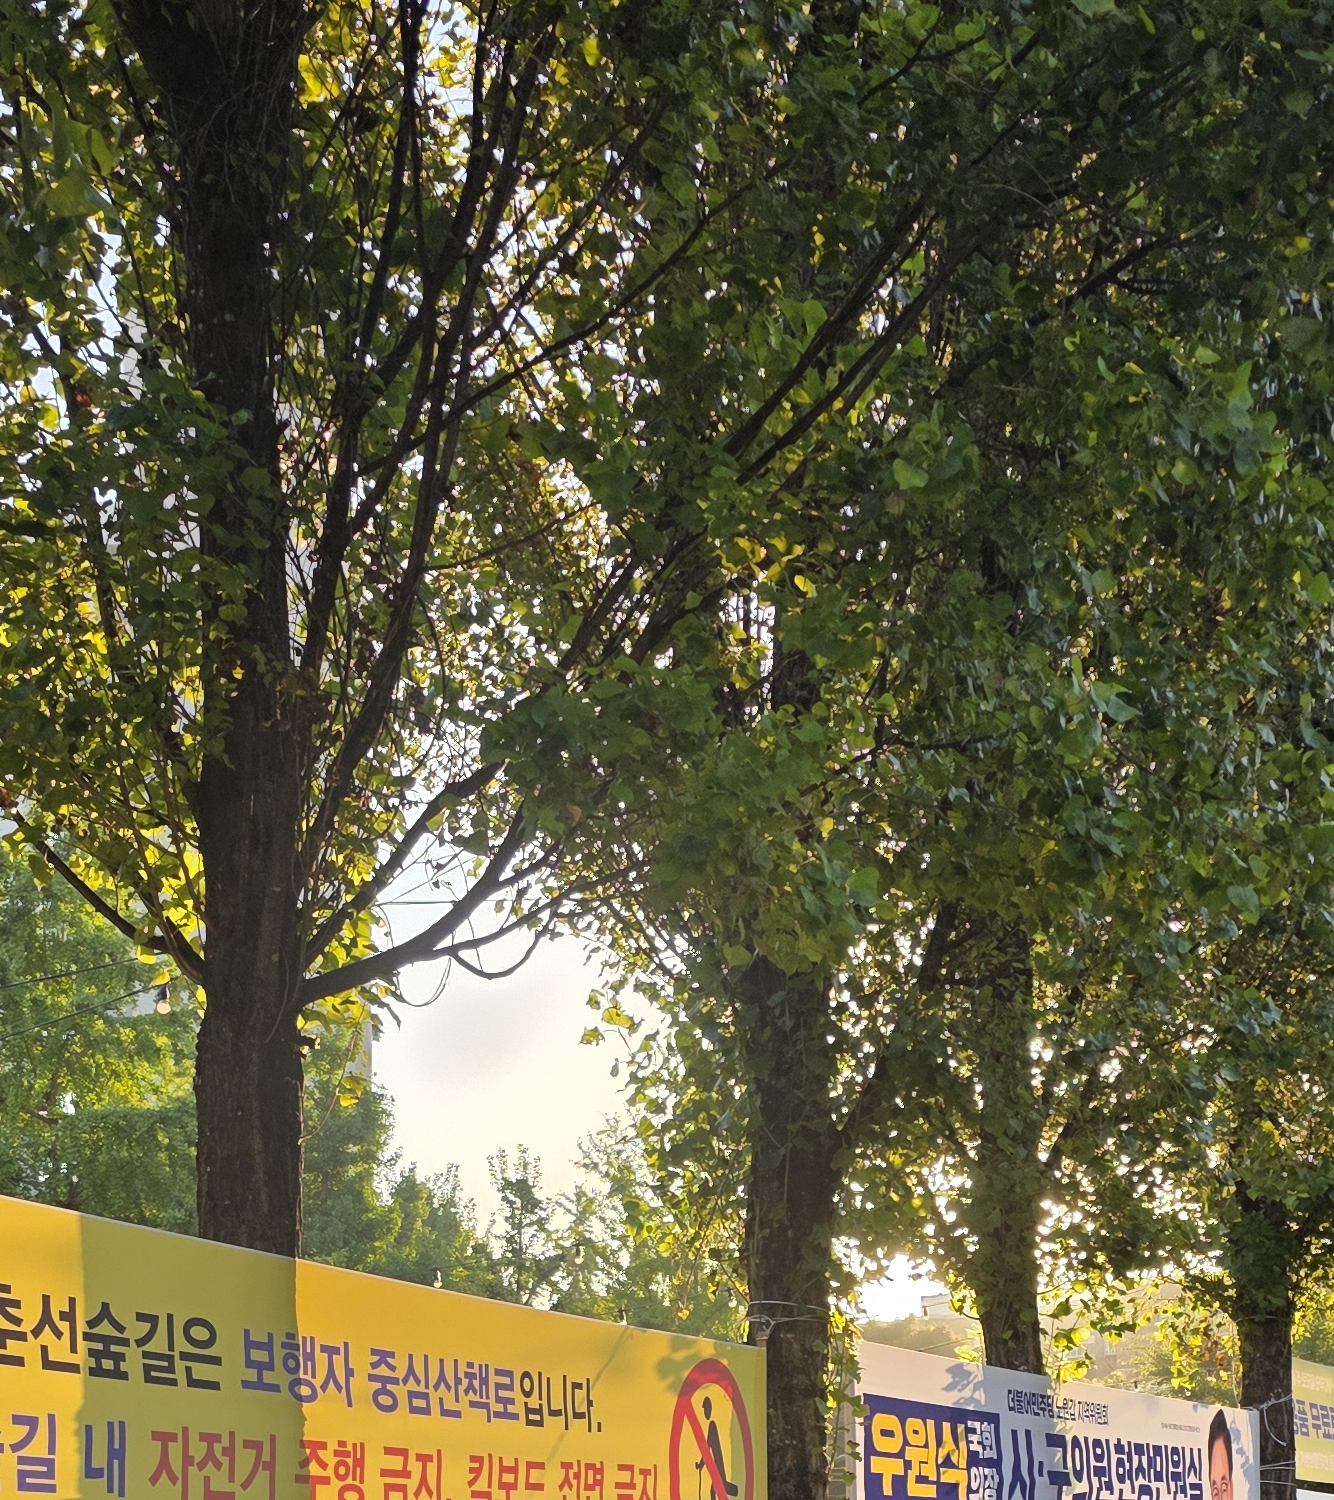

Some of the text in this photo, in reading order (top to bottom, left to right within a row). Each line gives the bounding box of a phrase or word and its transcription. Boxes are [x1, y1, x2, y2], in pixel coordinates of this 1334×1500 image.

[240, 1327, 355, 1408] 보행자
[367, 1346, 603, 1434] 중심산책로입니다.
[1007, 1388, 1109, 1426] 더불어민주당 노원갑 지역위원회
[83, 1420, 127, 1499] 내
[870, 1411, 969, 1500] 우원식
[967, 1419, 998, 1460] 국회
